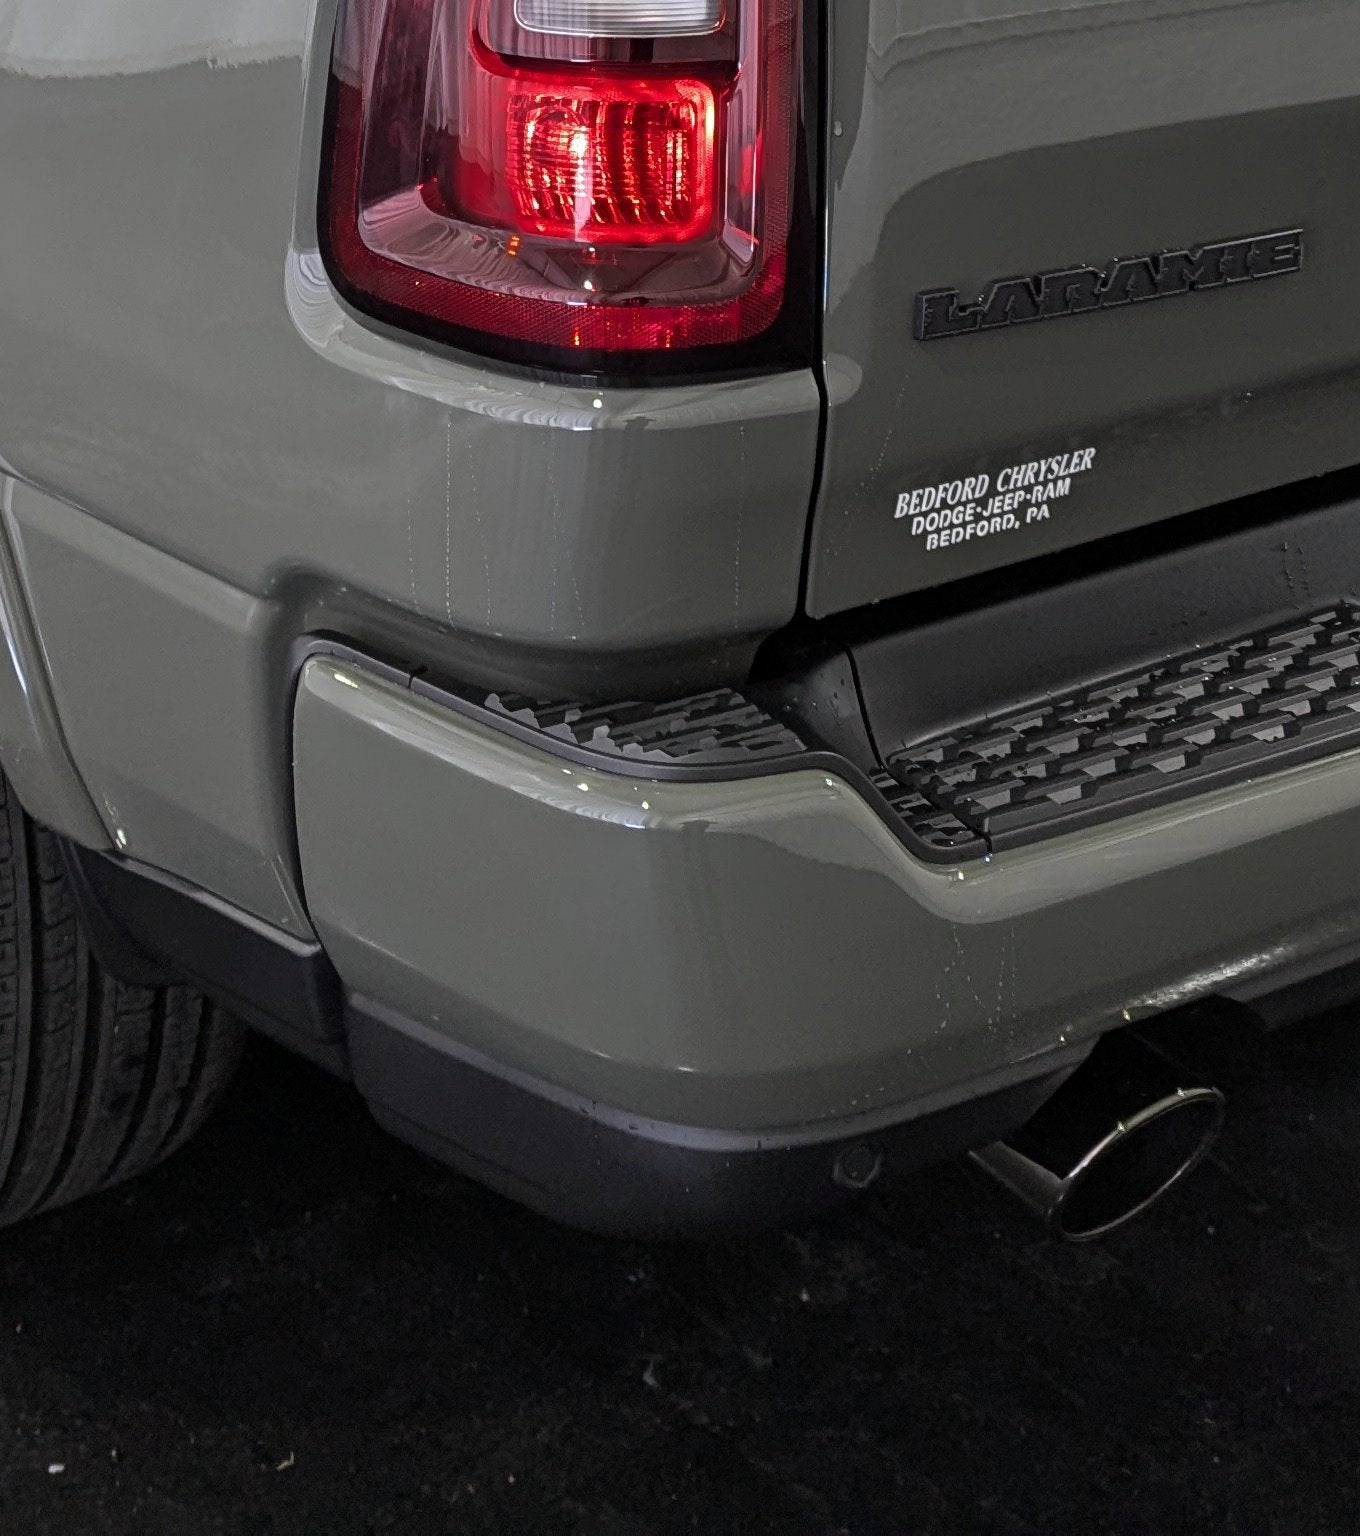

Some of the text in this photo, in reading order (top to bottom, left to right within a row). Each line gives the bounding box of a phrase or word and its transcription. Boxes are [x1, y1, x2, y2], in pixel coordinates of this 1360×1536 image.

[913, 228, 1305, 341] LARAMIE
[894, 447, 1097, 519] BEDFORD CHRYSLER
[926, 504, 1051, 551] BEDFORD, PA
